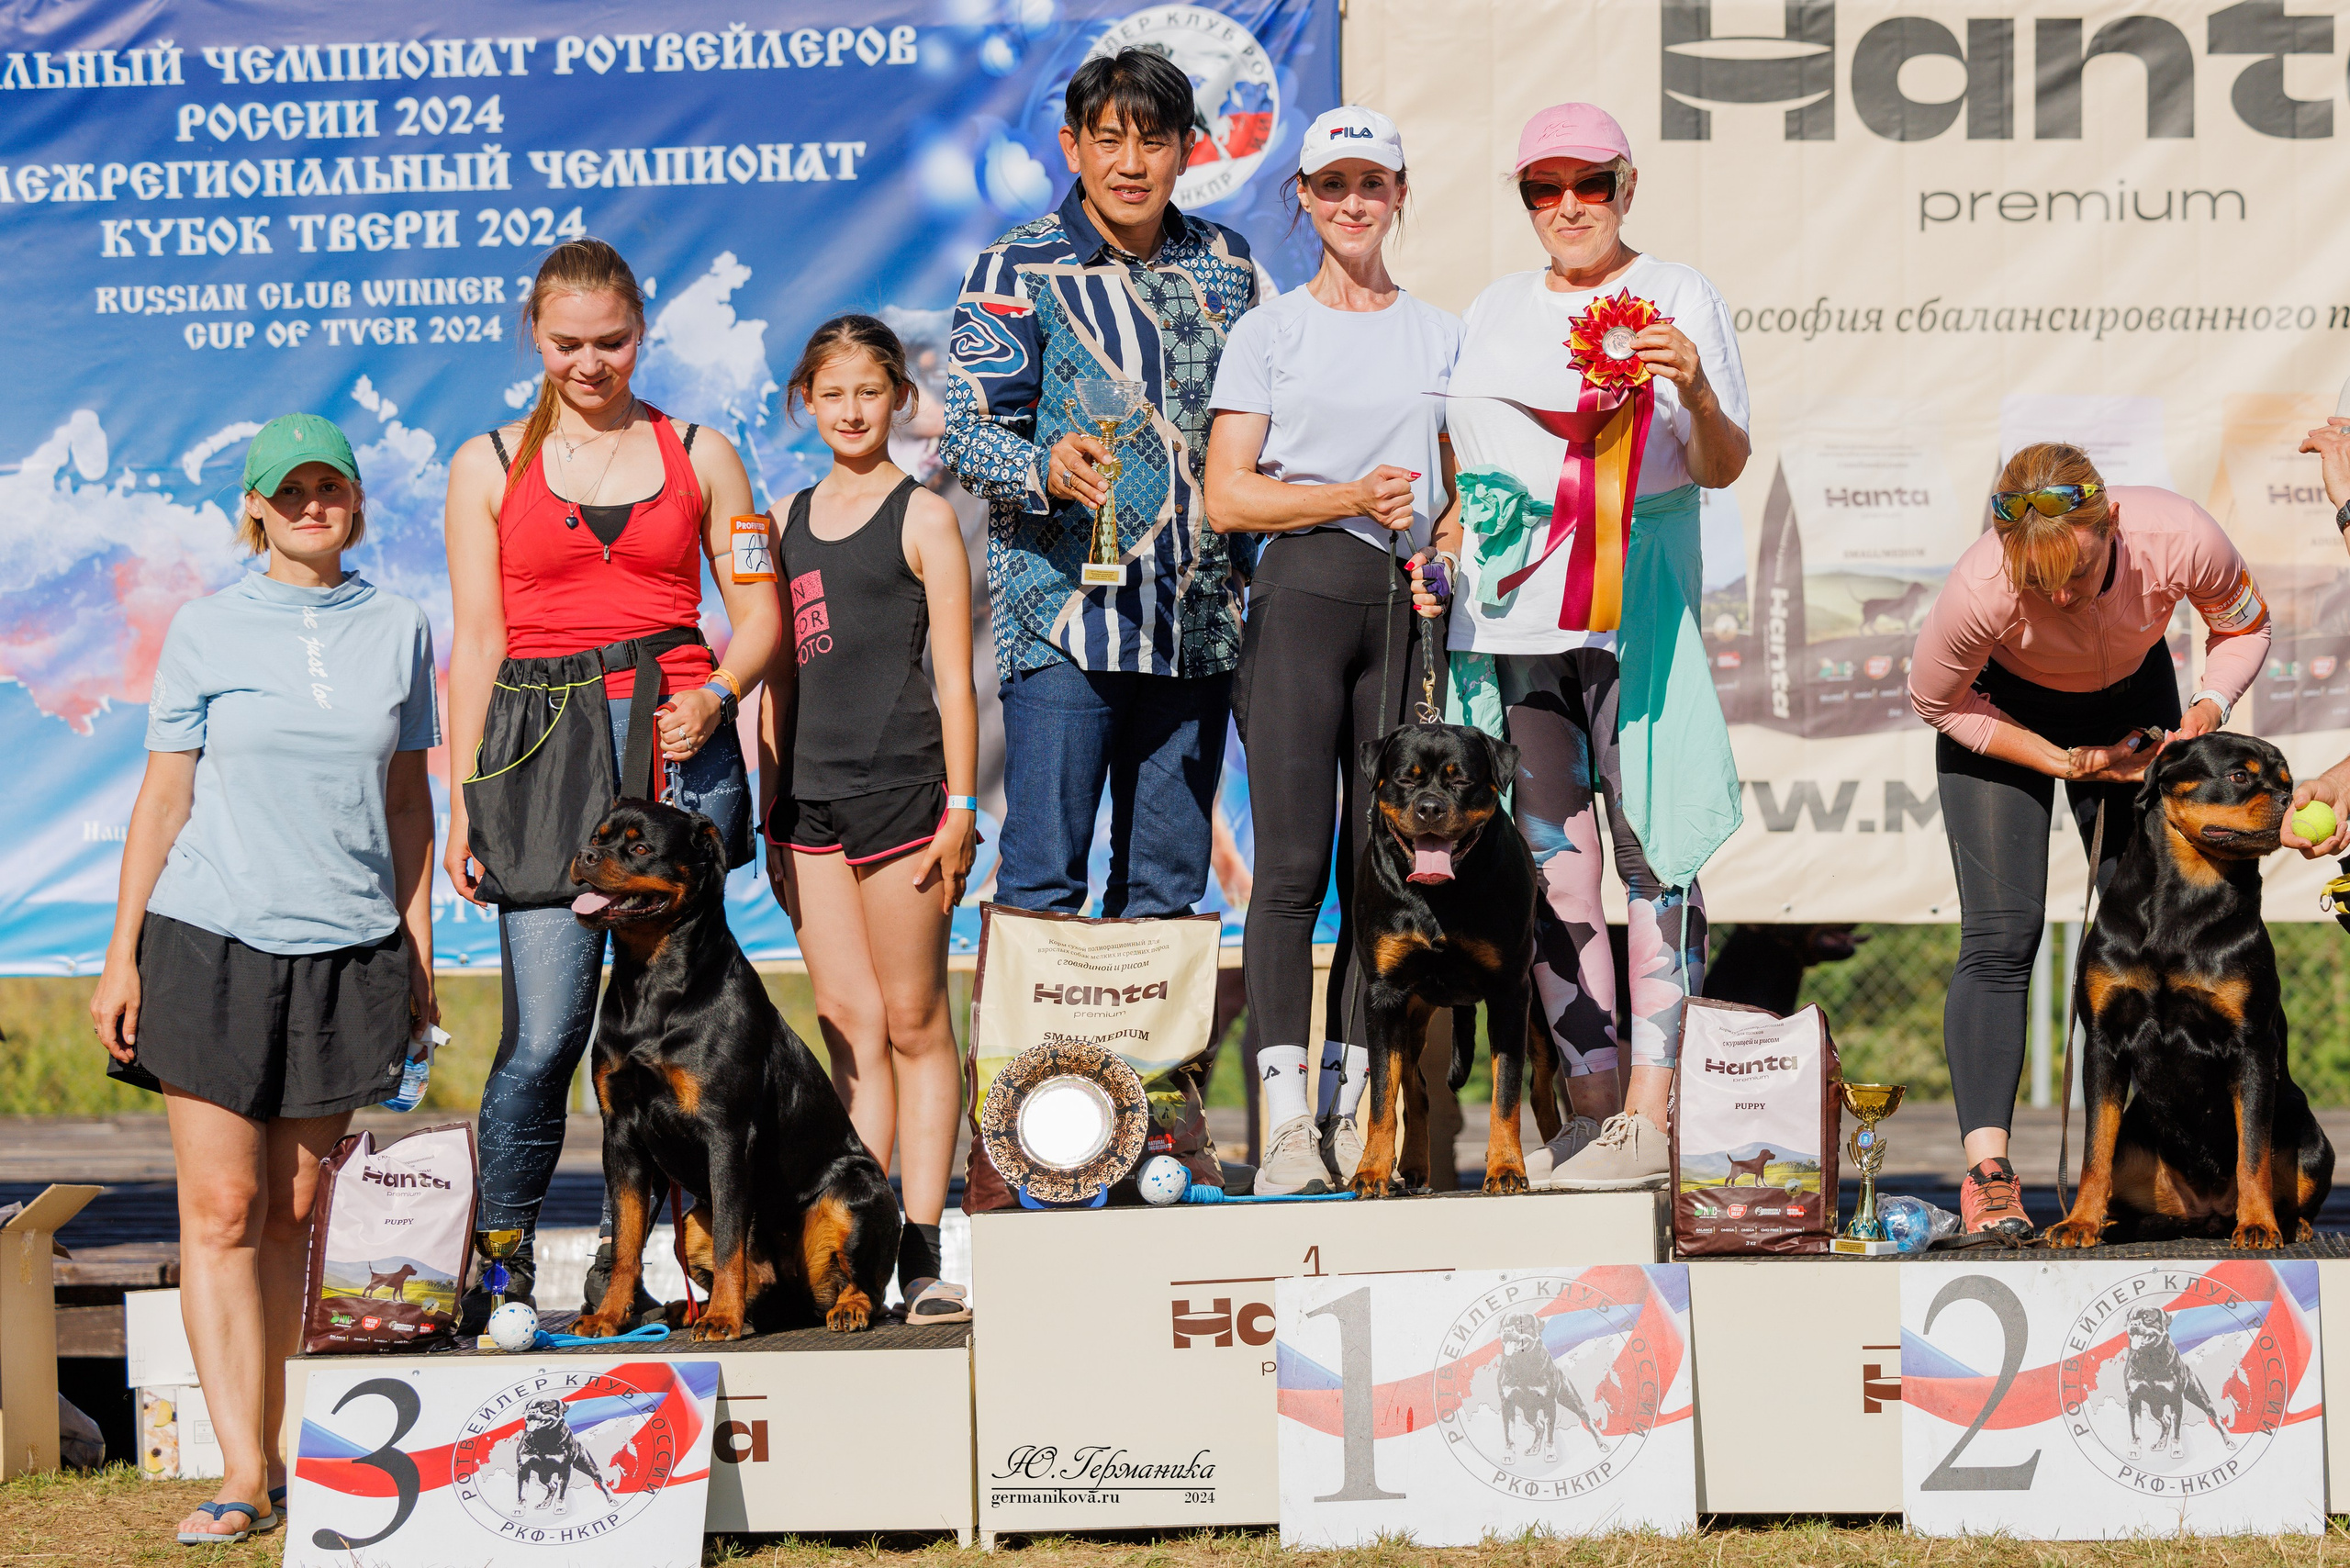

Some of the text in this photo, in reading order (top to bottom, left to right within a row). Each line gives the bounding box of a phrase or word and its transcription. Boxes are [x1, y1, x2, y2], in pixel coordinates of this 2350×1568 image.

[1167, 11, 1235, 42] КЛУБ
[0, 22, 917, 90] ЛЬНЫЙ ЧЕМПИОНАТ РОТВЕЙЛЕРОВ
[1660, 0, 2350, 141] Hant
[175, 94, 504, 142] РОССИИ 2024
[1330, 127, 1373, 140] FILA
[528, 141, 867, 189] ЧЕМПИОНАТ
[1919, 181, 2247, 232] premium
[102, 206, 587, 257] КУБОК ТВЕРИ 2024
[95, 282, 248, 316] RUSSIAN
[258, 279, 352, 308] CLUB
[361, 276, 506, 308] WINNER
[184, 315, 503, 350] CUP OF TVER 2024
[1734, 297, 1883, 341] ософия
[1897, 297, 2316, 341] сбалансированного
[1824, 487, 1930, 507] Hanta
[796, 610, 824, 635] OR
[1769, 587, 1790, 720] Hanta
[1063, 958, 1113, 971] говядиной
[1121, 960, 1149, 972] рисом
[1034, 980, 1168, 1006] Hanta
[1073, 1010, 1126, 1019] premium
[1044, 1029, 1149, 1044] SMALL/MEDIUM
[1706, 1056, 1796, 1075] Hanta
[362, 1165, 451, 1190] Hanta
[1438, 1281, 1655, 1445] РОТВЕЙЛЕР КЛУБ РОССИИ
[2063, 1274, 2285, 1438] РОТВЕЙЛЕР КЛУБ РОССИИ
[1306, 1286, 1406, 1503] 1
[1920, 1274, 2042, 1492] 2
[458, 1377, 549, 1502] РОТВЕЙЛЕР
[565, 1374, 635, 1402] КЛУБ
[641, 1403, 675, 1497] РОССИИ
[311, 1377, 421, 1551] 3
[1492, 1461, 1613, 1497] РКФ-НКПР
[2118, 1459, 2240, 1494] РКФ-НКПР
[499, 1513, 620, 1543] РКФ-НКПР
